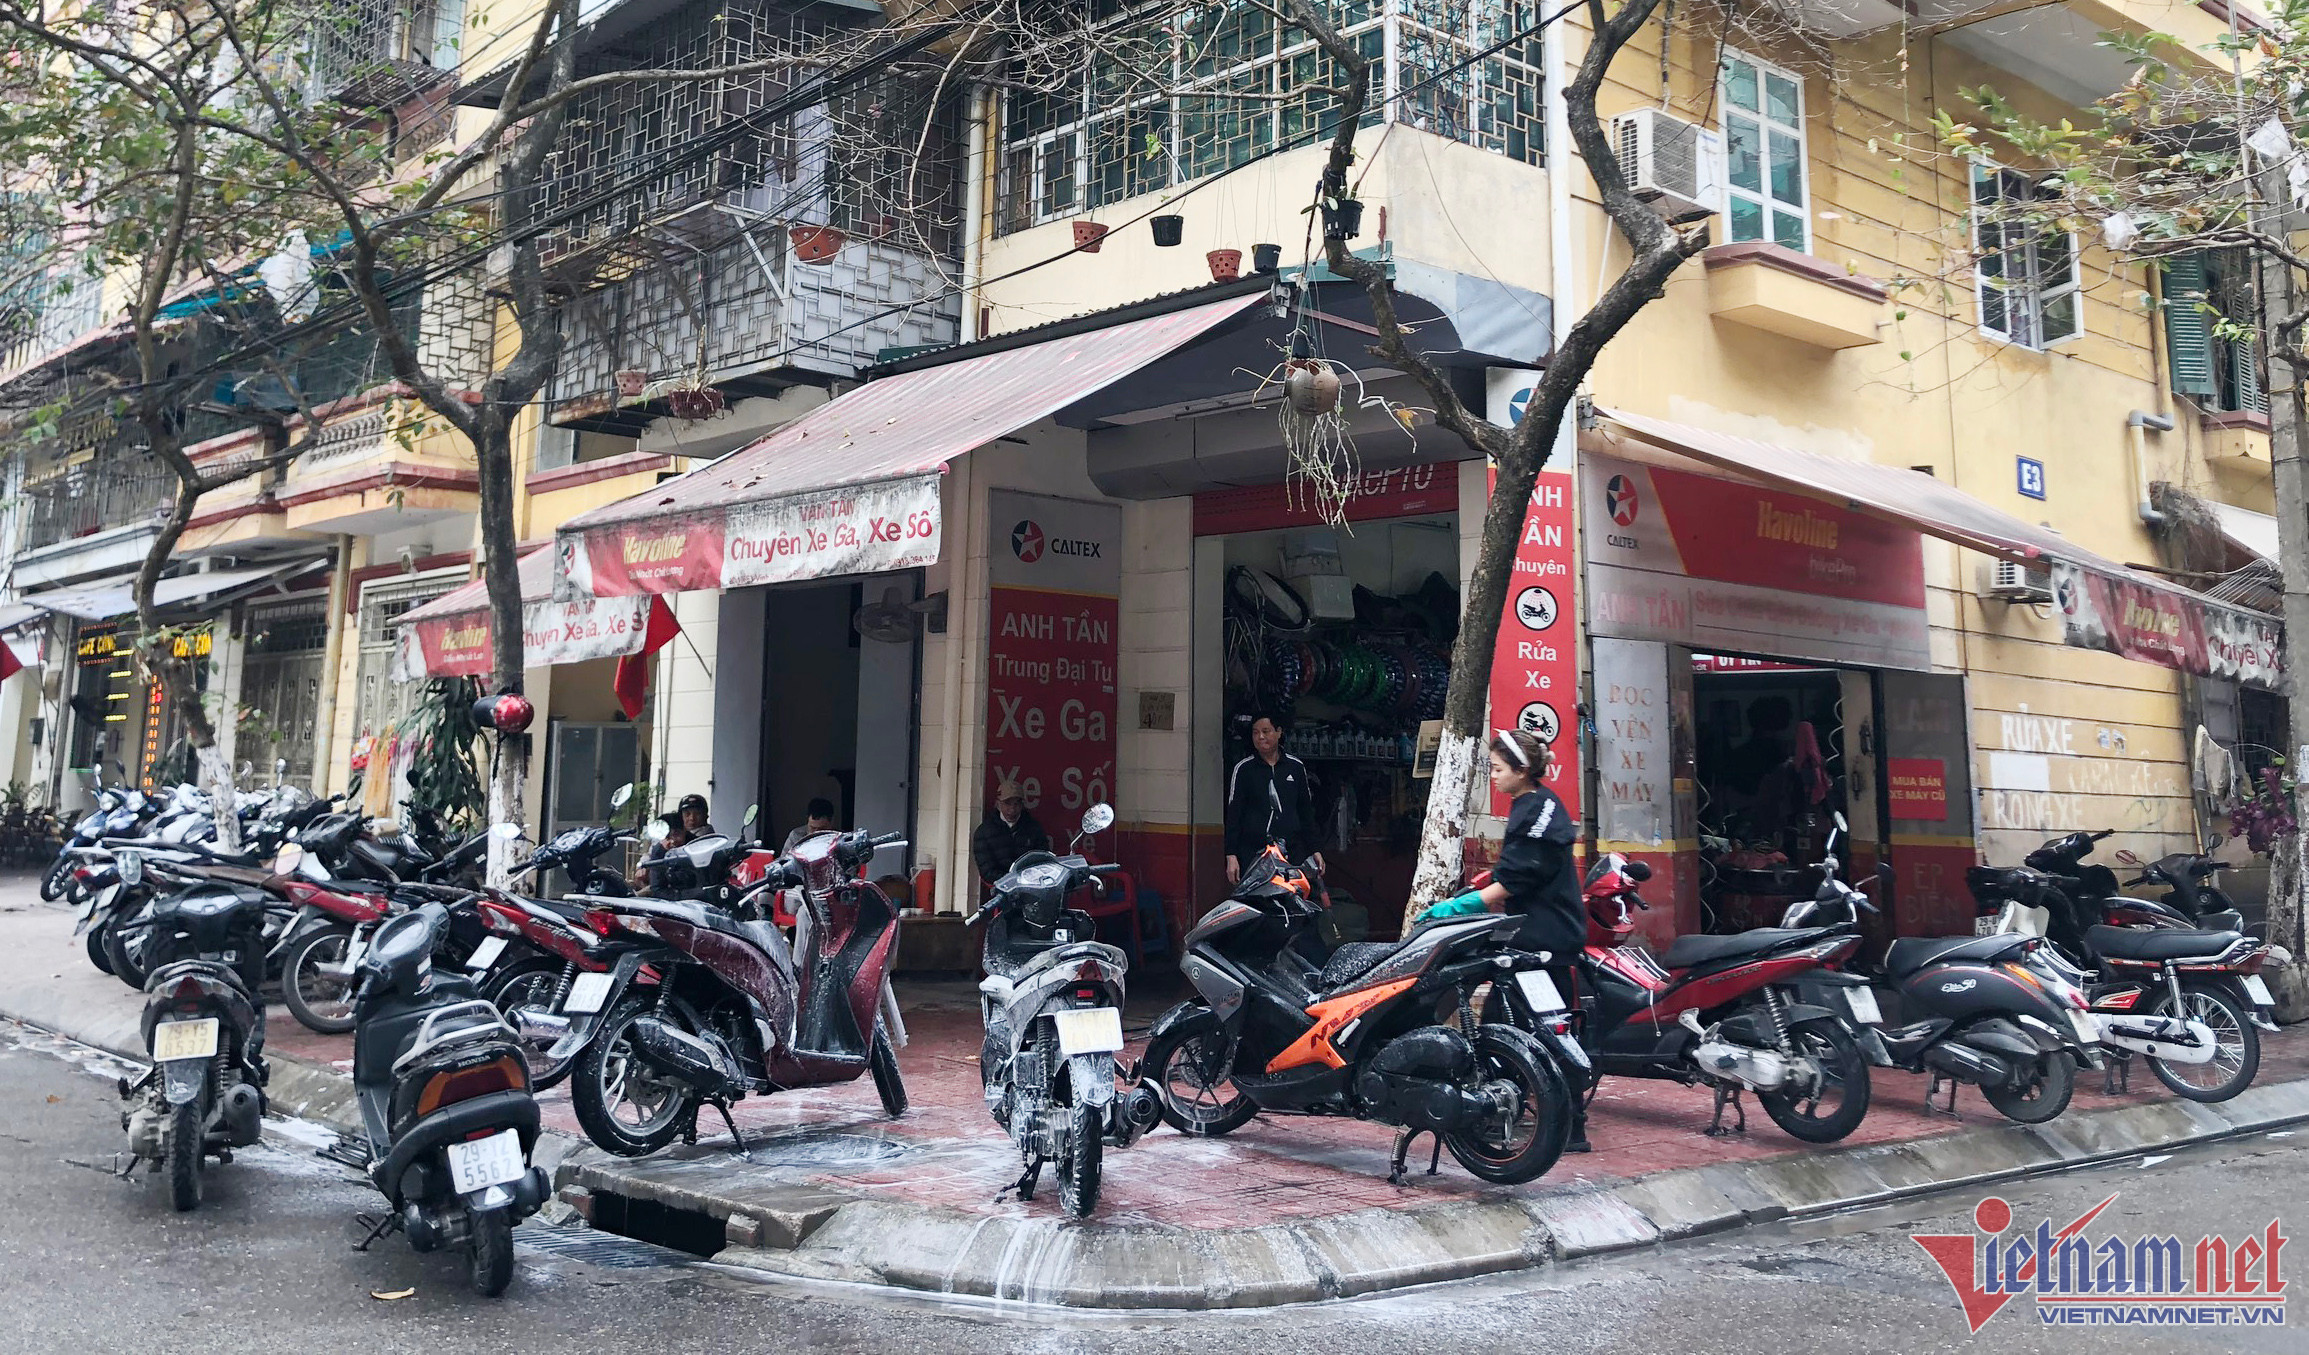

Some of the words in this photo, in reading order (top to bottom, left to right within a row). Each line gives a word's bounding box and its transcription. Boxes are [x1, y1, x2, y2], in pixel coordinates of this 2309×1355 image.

[2021, 463, 2042, 493] E3
[1529, 485, 1563, 508] NH
[731, 530, 801, 563] Chuyên
[806, 528, 828, 553] Xe
[834, 522, 860, 550] Ga,
[868, 516, 902, 543] Xe
[906, 506, 935, 539] Số
[1523, 515, 1563, 547] ẦN
[1757, 500, 1838, 550] Havoline
[623, 533, 687, 565] Havoline
[1051, 538, 1101, 558] CALTEX
[1607, 534, 1641, 551] CALTEX
[1513, 558, 1567, 577] huyên
[563, 621, 584, 642] Xe
[605, 615, 626, 635] Xe
[1000, 612, 1054, 640] ANH
[1062, 608, 1109, 645] TẦN
[1517, 639, 1558, 662] Rửa
[993, 653, 1050, 684] Trung
[1055, 657, 1086, 686] Đại
[1525, 670, 1552, 689] Xe
[996, 695, 1046, 739] Xe
[1059, 699, 1107, 741] Ga
[1620, 749, 1647, 771] XE
[1060, 760, 1112, 810] Số
[1612, 776, 1655, 802] MÁY
[1892, 776, 1917, 786] MUA
[1919, 775, 1942, 787] BÁN
[1889, 790, 1904, 799] XE
[1905, 789, 1929, 800] MÁY
[457, 1054, 491, 1068] HONDA
